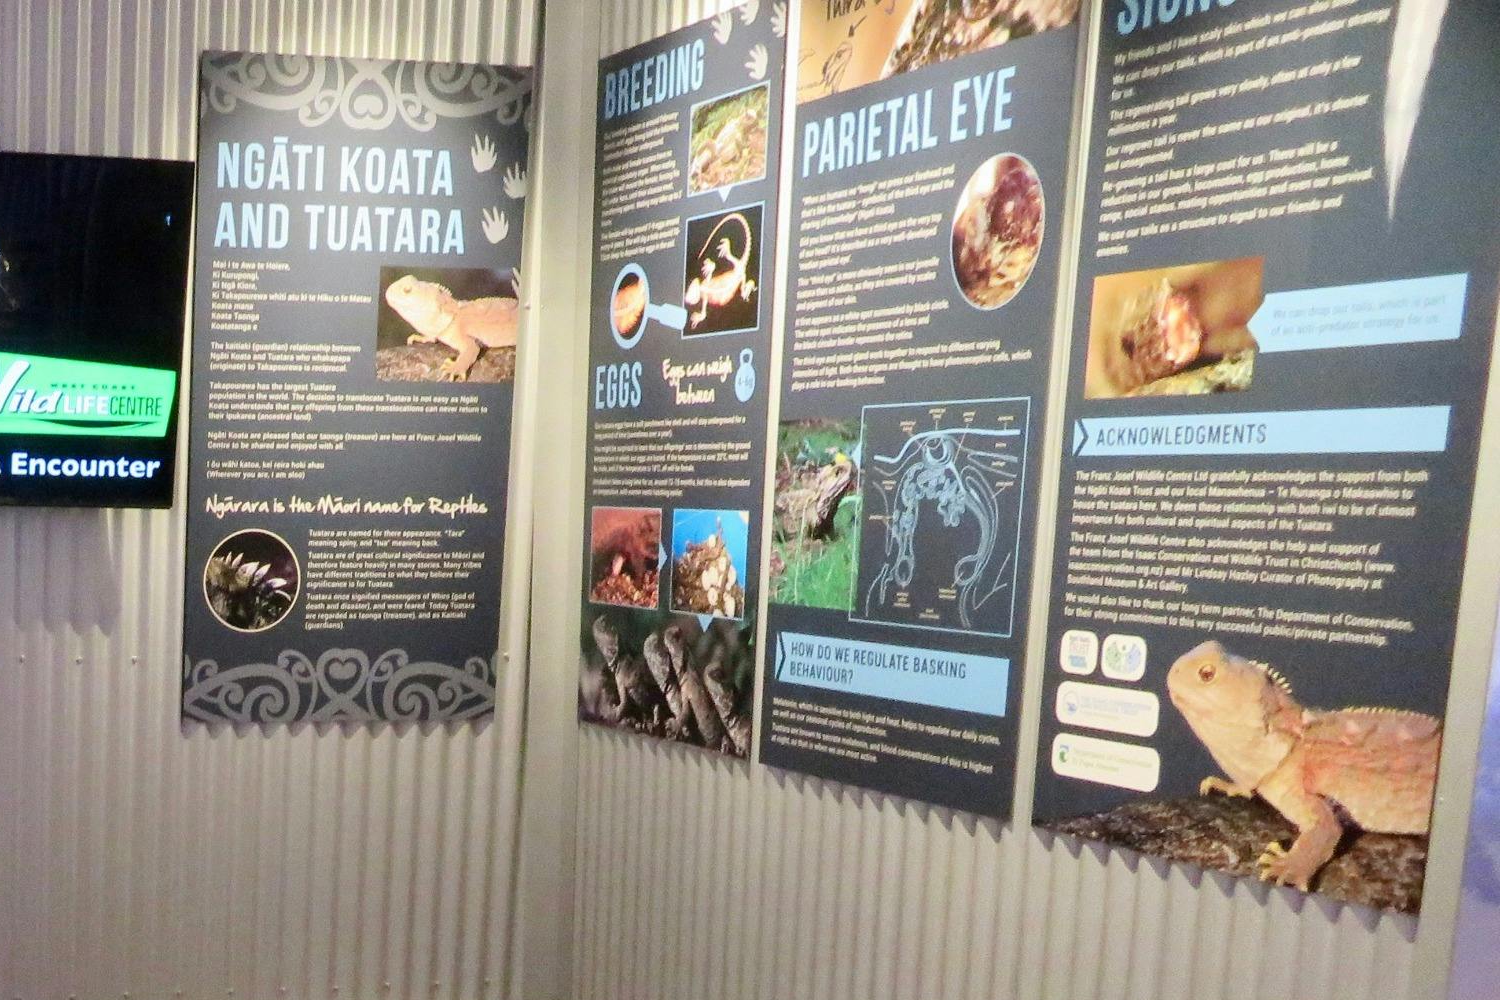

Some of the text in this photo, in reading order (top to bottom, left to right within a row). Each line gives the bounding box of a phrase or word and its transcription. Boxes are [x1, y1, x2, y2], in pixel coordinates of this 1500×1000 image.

[605, 38, 705, 119] BREEDING
[802, 65, 1017, 178] PARIETAL EYE
[217, 136, 454, 196] NGĀTI KOATA
[214, 202, 465, 255] AND TUATARA
[256, 382, 270, 391] has
[271, 382, 283, 391] the
[284, 382, 308, 393] largest
[310, 383, 337, 391] Tuatara
[595, 361, 642, 409] EGGS
[1096, 423, 1267, 446] ACKNOWLEDGMENTS
[11, 452, 161, 478] Encounter
[1075, 470, 1429, 483] The Franz Josef Wildlife Centre Ltd gratefully acknowledges the support from both
[206, 493, 488, 519] Ngārara is the Māori name for Reptiles
[790, 662, 854, 684] BEHAVIOUR?
[791, 641, 966, 679] HOW DO WE REGULATE BASKING
